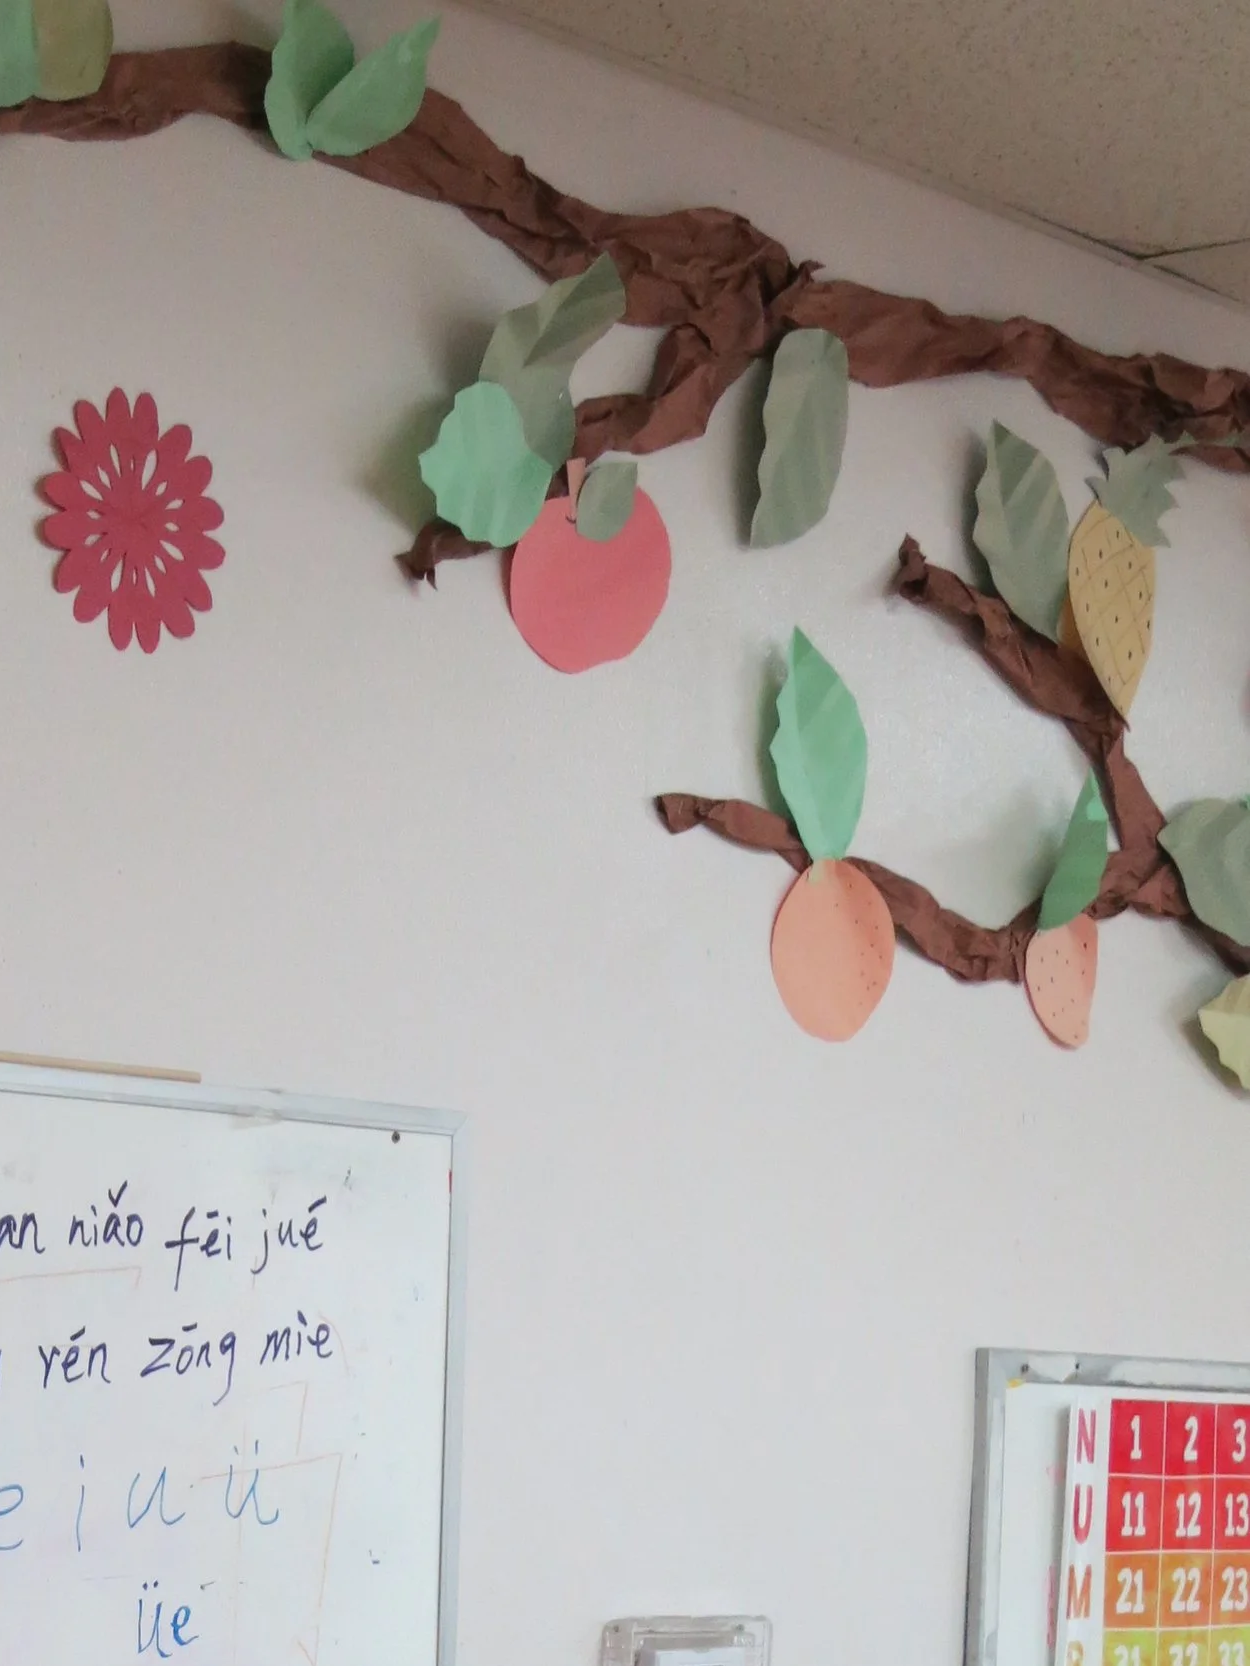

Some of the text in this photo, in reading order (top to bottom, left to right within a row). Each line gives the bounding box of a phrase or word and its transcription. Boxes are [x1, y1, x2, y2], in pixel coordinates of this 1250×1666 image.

[1130, 1414, 1247, 1463] 1 2 3
[77, 1454, 86, 1553] i
[127, 1466, 186, 1530] u
[1120, 1491, 1250, 1538] 11 12 13
[1115, 1566, 1249, 1614] 21 22 23
